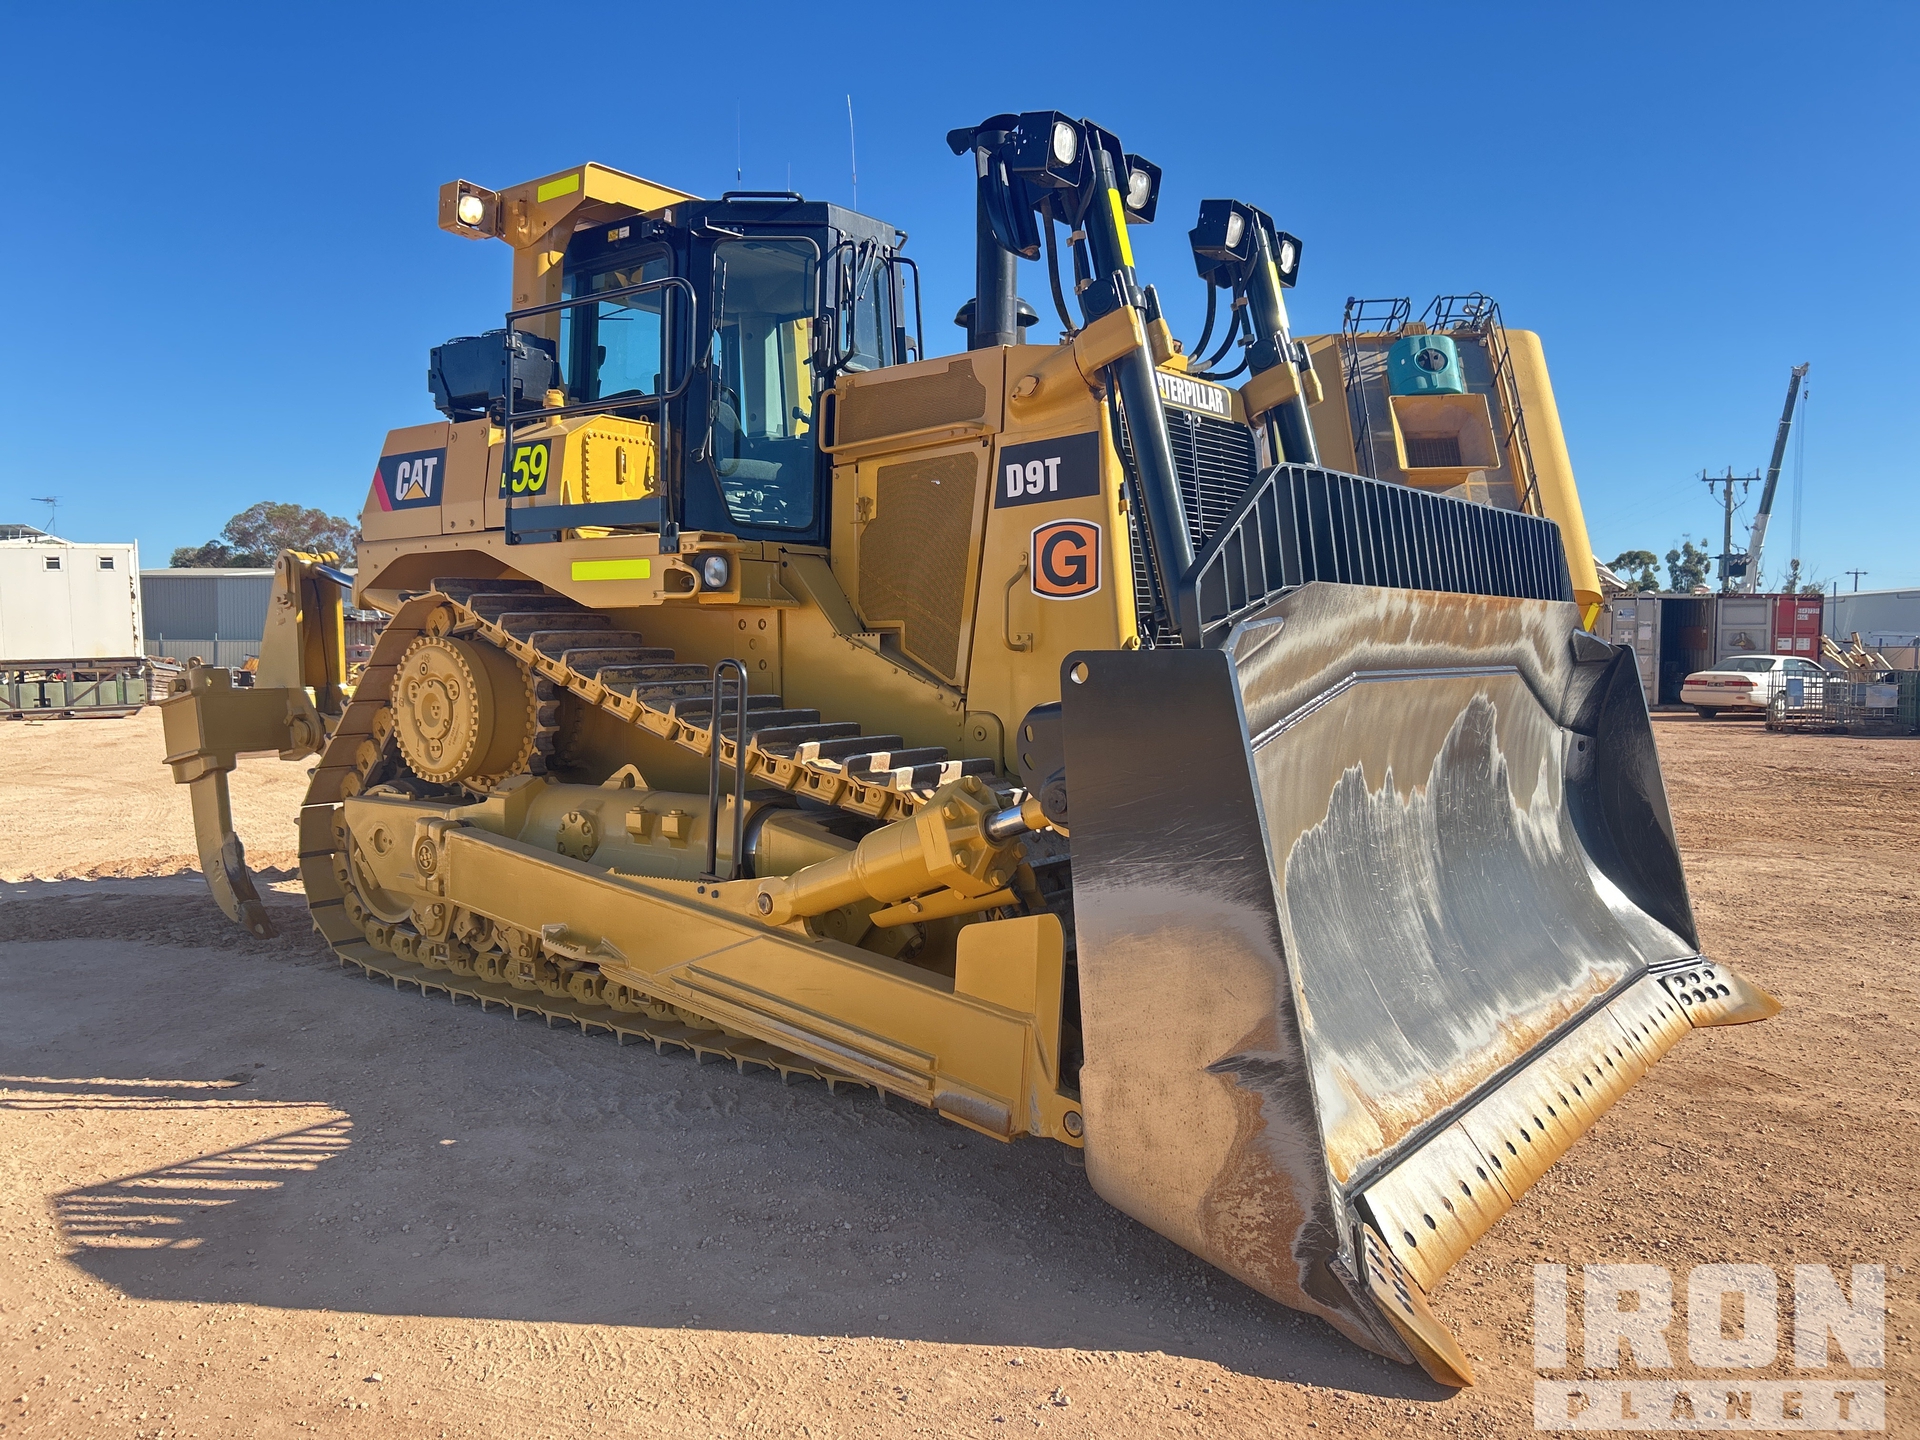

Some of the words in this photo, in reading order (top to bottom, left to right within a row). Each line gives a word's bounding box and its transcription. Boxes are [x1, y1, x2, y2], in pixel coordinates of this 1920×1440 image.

[1156, 371, 1224, 414] ATERPILLAR
[395, 457, 438, 501] CAT
[1005, 457, 1061, 498] D9T
[1041, 530, 1087, 587] G
